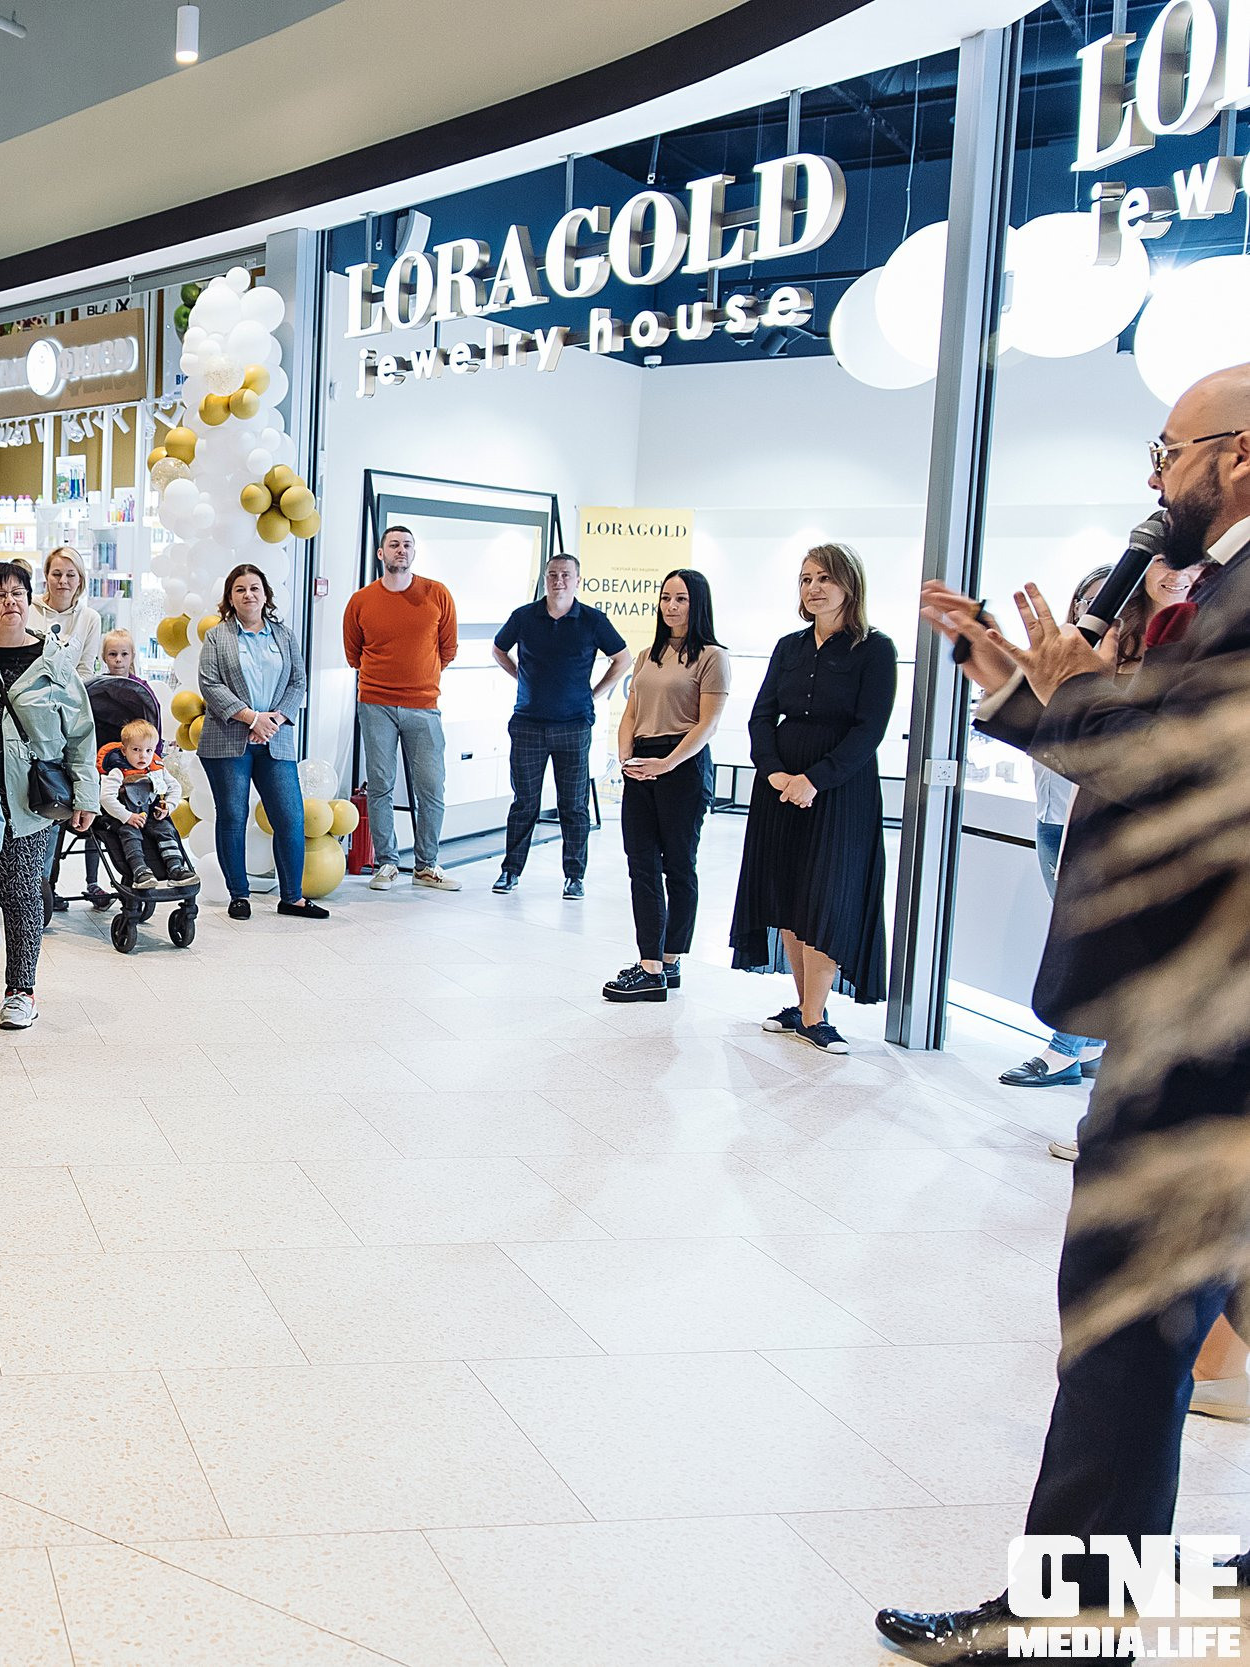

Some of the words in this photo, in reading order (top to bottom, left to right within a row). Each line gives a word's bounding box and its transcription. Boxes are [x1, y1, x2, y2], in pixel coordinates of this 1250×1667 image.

[344, 153, 846, 339] LORAGOLD
[356, 325, 571, 398] jewelry
[589, 286, 814, 353] house
[586, 522, 687, 538] LORAGOLD
[582, 578, 663, 593] ЮВЕЛИРН
[594, 601, 658, 617] ЯРМАРК
